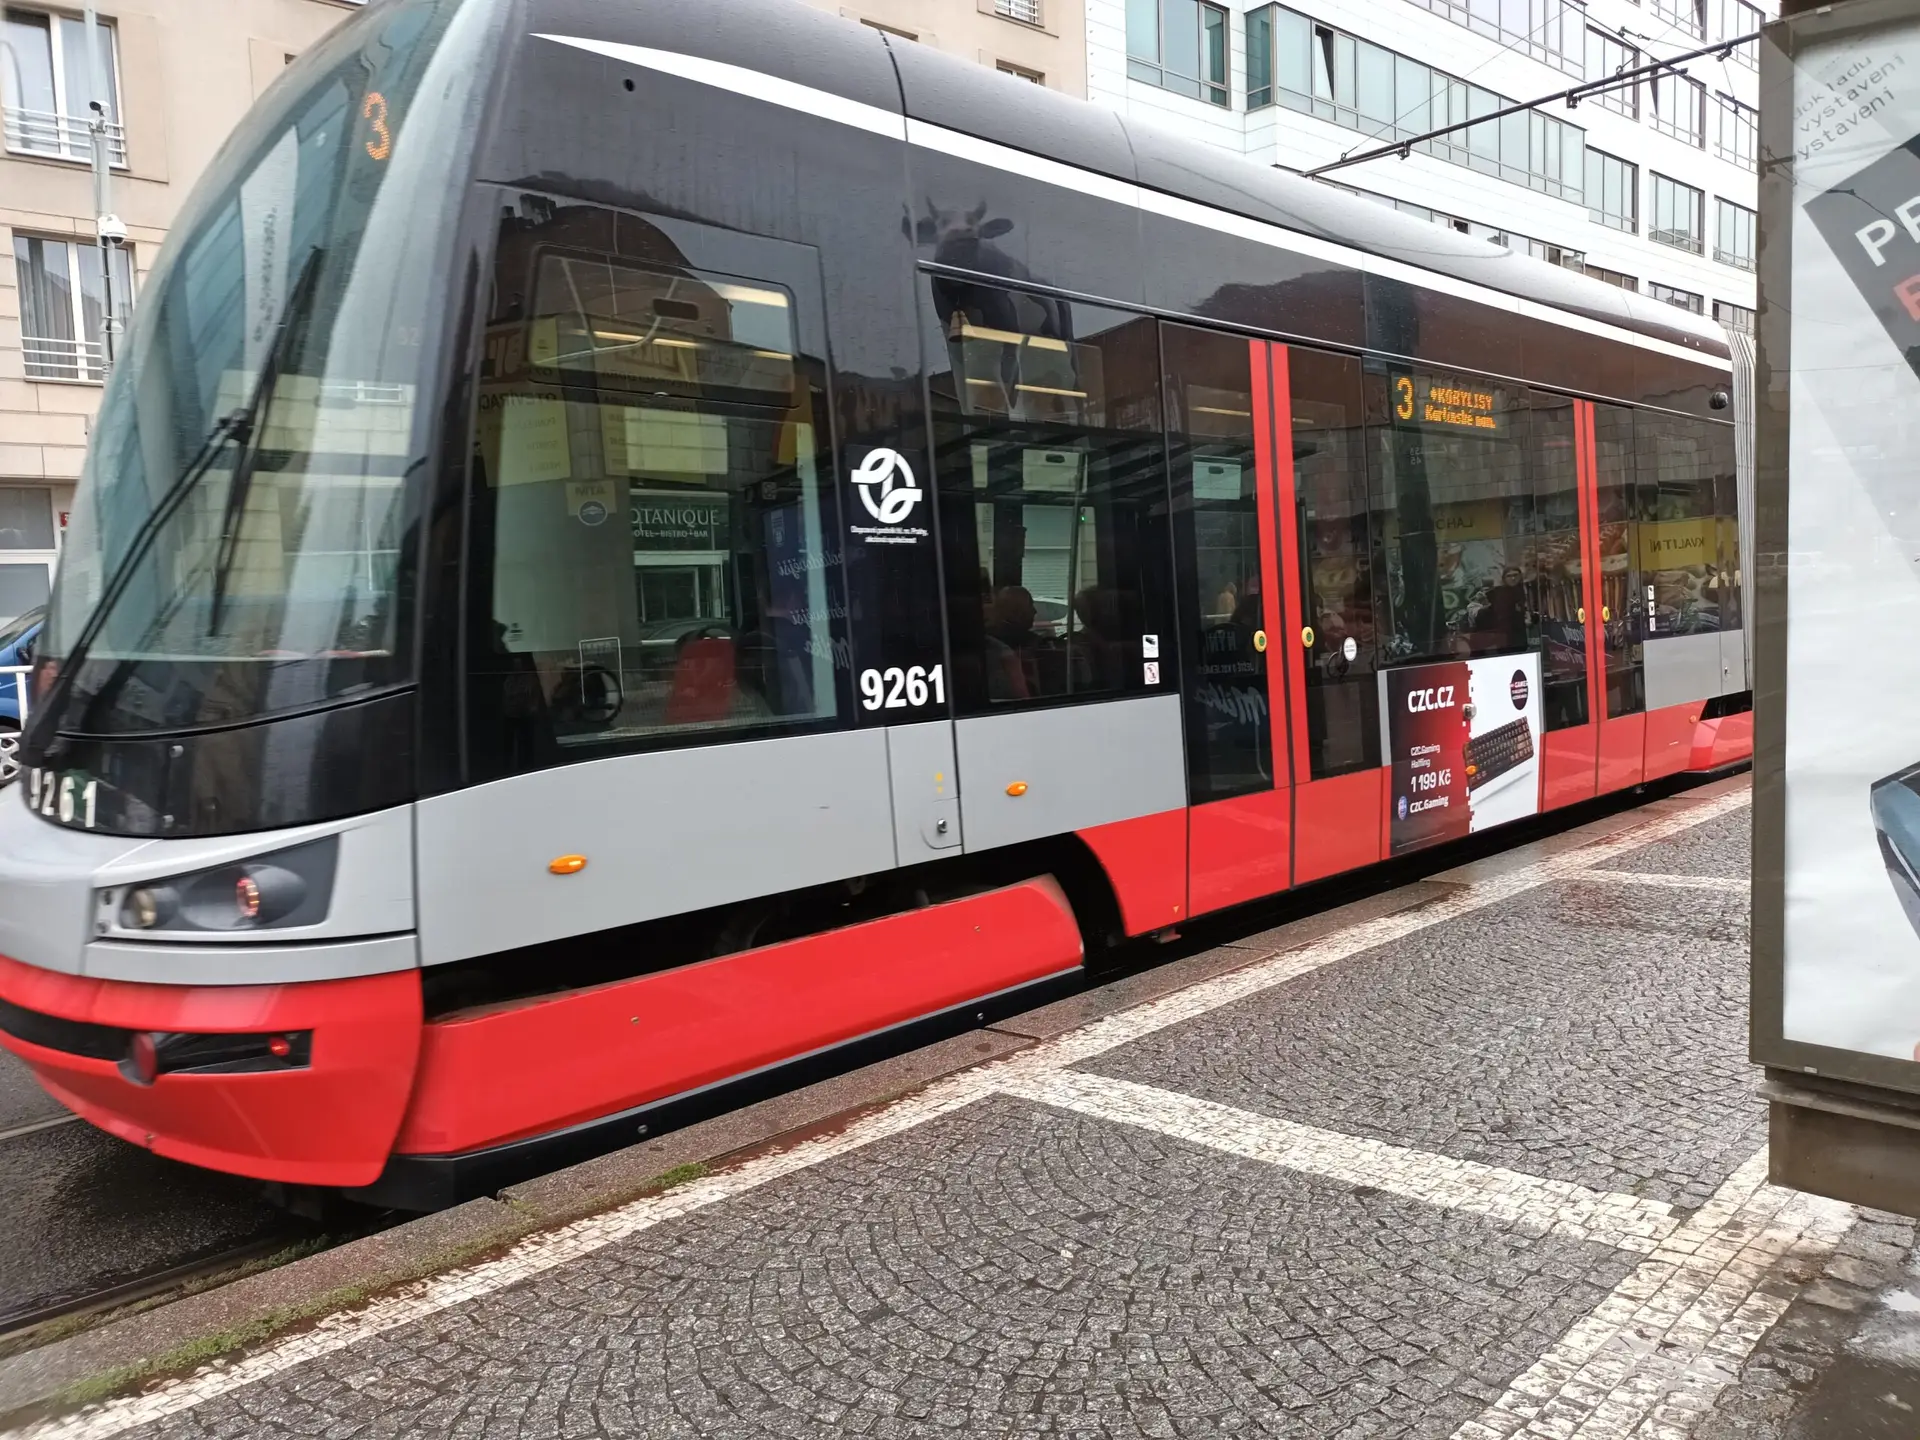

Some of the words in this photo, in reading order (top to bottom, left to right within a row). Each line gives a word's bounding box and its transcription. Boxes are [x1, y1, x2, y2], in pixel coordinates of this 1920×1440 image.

[363, 91, 391, 162] 3
[1396, 376, 1414, 420] 3
[629, 508, 720, 528] OTANIQUE
[860, 664, 947, 711] 9261
[1408, 685, 1455, 713] CZC.CZ
[1438, 768, 1451, 787] Kč
[29, 767, 98, 828] 9261
[1410, 795, 1449, 813] CZC.Gaming
